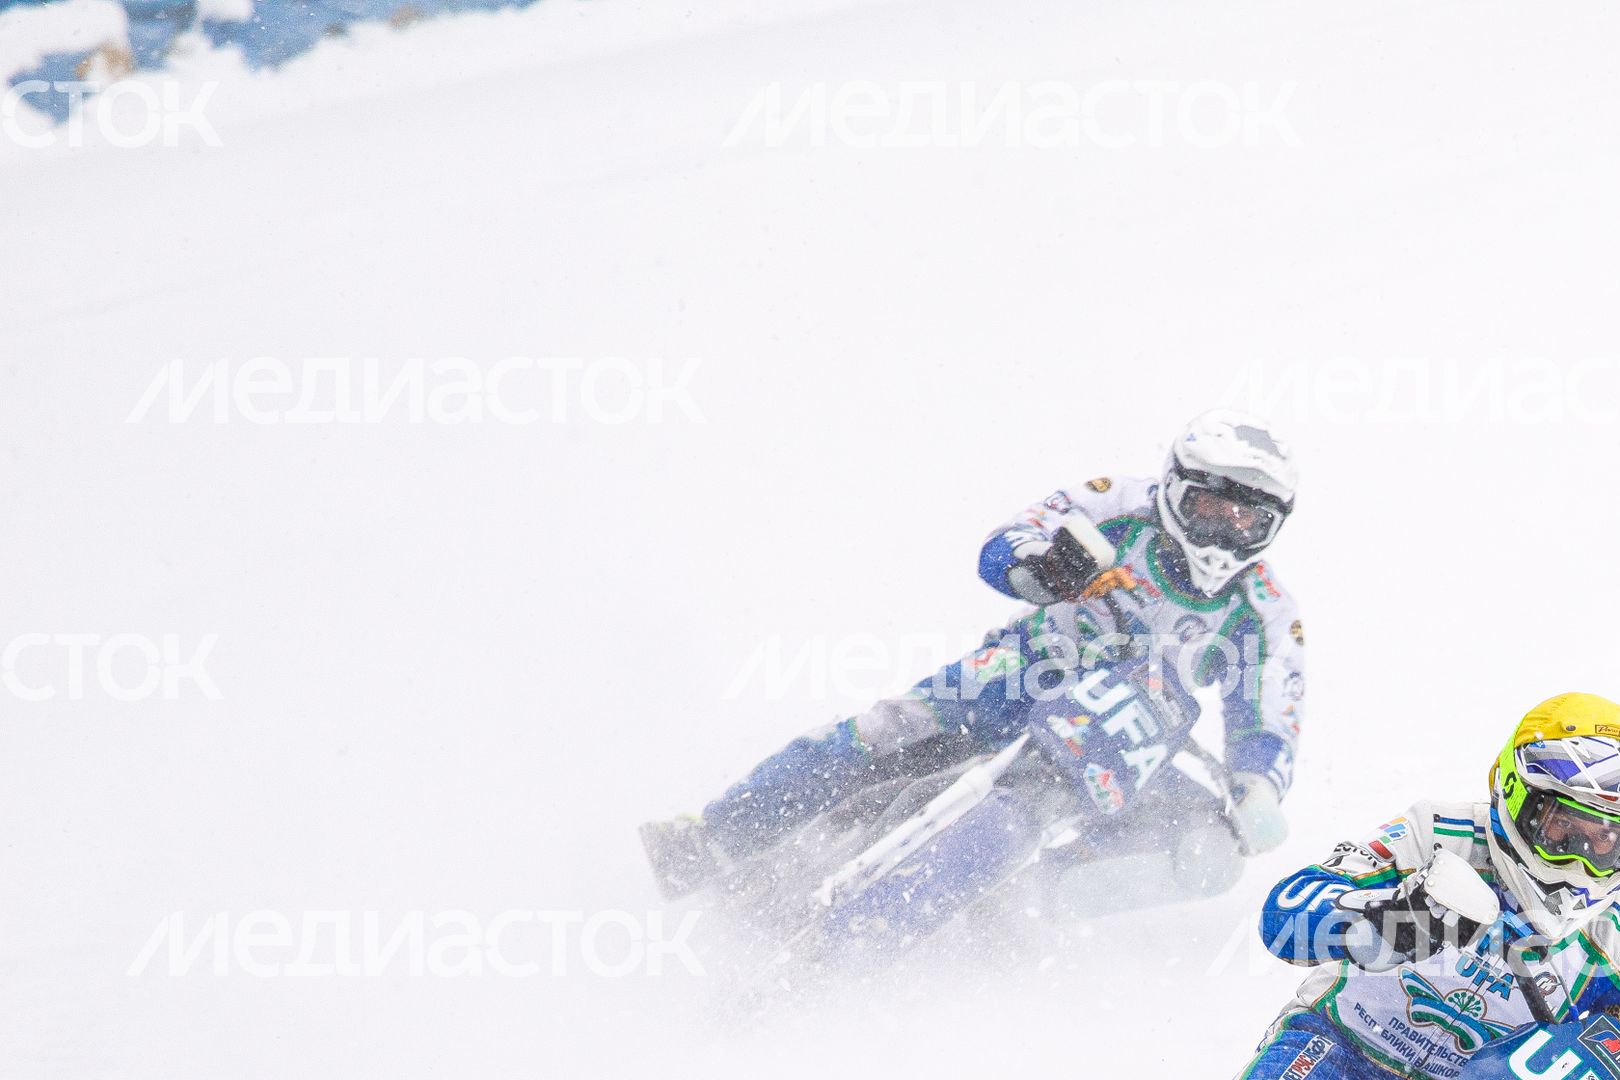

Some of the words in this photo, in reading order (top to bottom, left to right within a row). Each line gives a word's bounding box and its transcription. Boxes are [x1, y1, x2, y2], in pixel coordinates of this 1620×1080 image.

[1074, 669, 1168, 792] UFA
[1455, 954, 1514, 1001] UFA
[1354, 1002, 1415, 1062] РЕСПБЛИКИ
